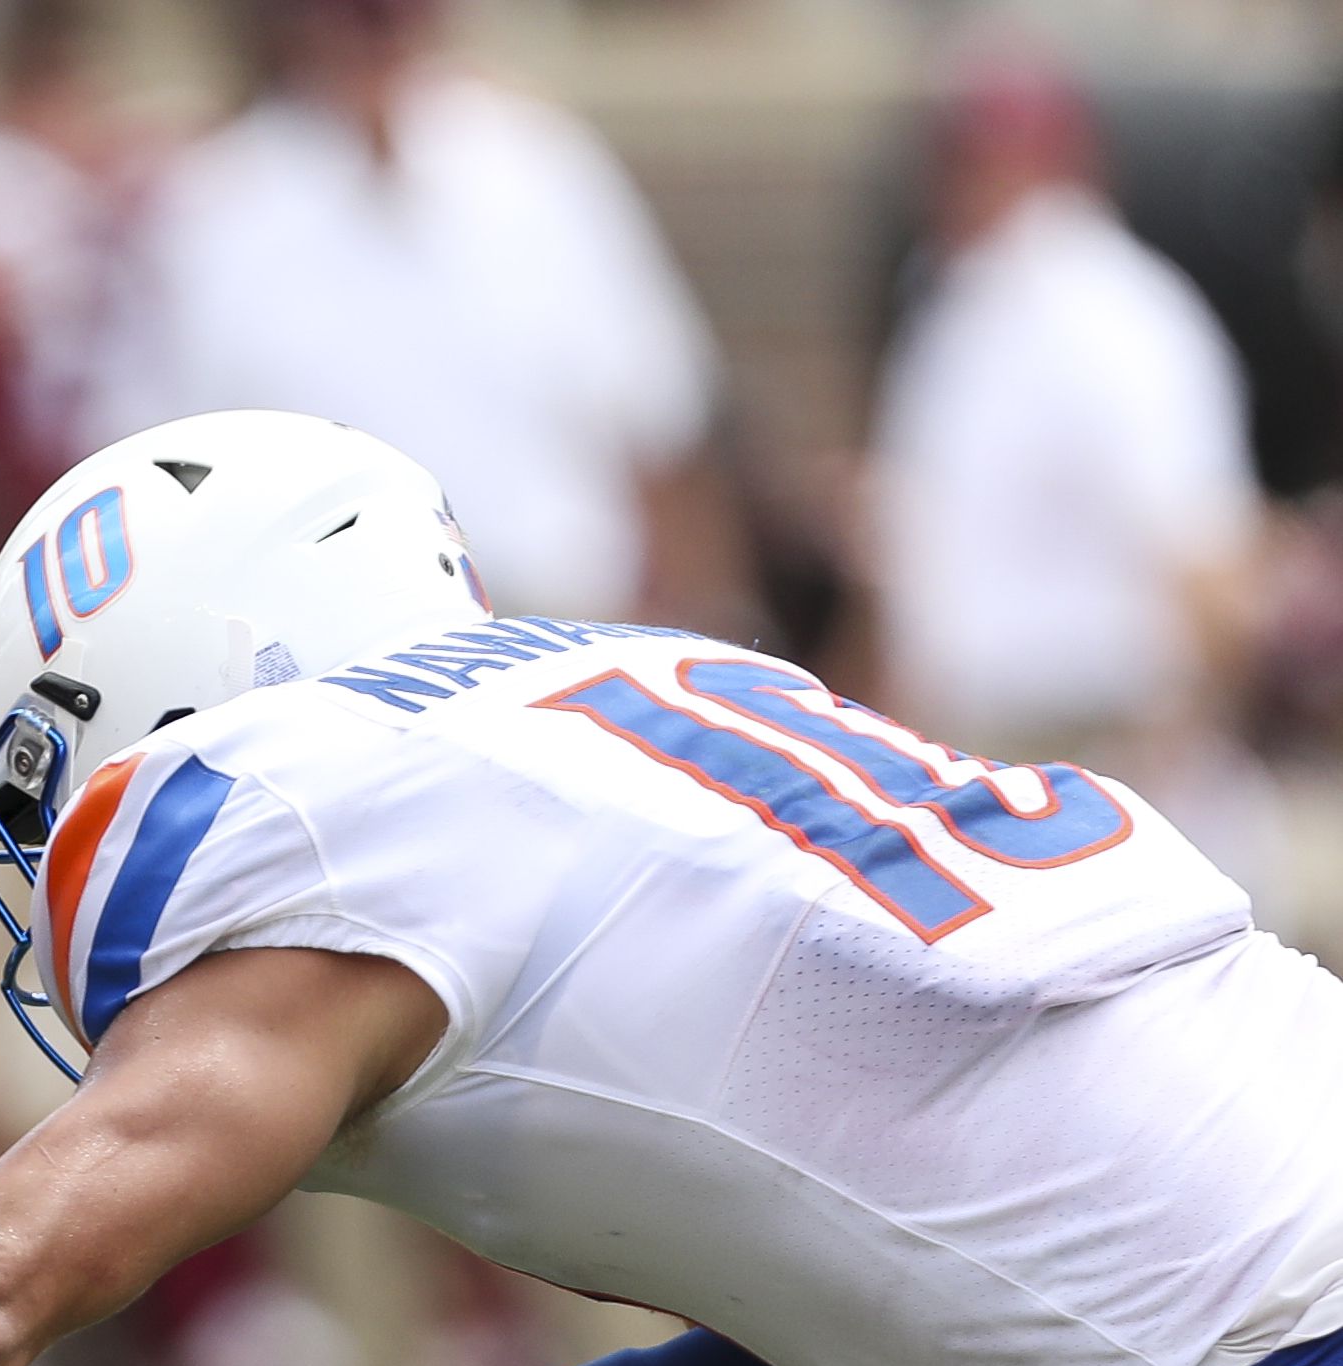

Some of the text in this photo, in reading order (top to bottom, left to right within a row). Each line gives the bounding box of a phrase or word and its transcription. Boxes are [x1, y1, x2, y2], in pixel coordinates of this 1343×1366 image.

[16, 484, 134, 662] 10
[316, 615, 707, 714] NAWA
[525, 657, 1133, 945] 10
